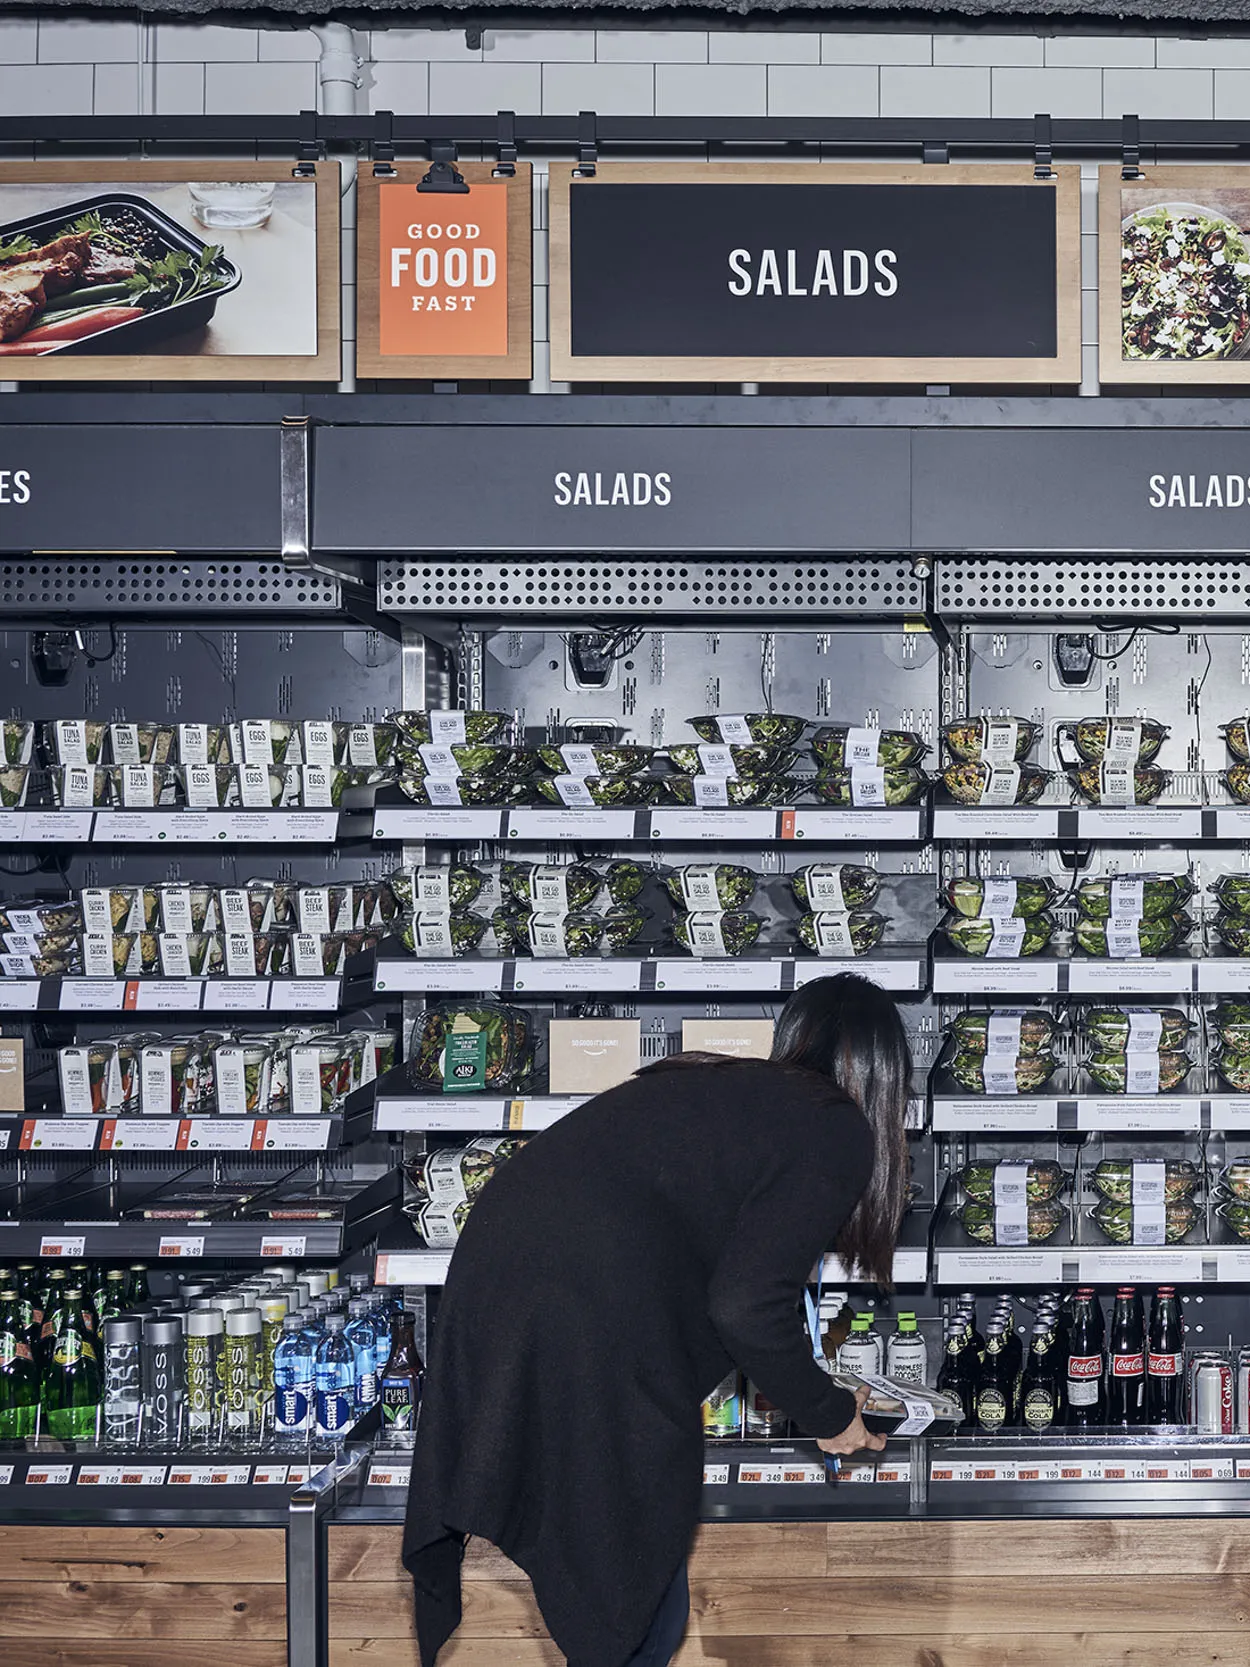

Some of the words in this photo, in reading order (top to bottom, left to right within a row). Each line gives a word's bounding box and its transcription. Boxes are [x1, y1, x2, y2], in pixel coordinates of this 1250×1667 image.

[408, 223, 479, 239] GOOD
[391, 247, 496, 288] FOOD
[728, 248, 898, 297] SALADS
[412, 295, 476, 311] FAST
[554, 471, 672, 506] SALADS
[249, 730, 266, 742] EGGS
[310, 731, 328, 742] EGGS
[353, 732, 369, 743] EGGS
[192, 772, 210, 783] EGGS
[245, 772, 263, 783] EGGS
[309, 774, 326, 785] EGGS
[227, 904, 244, 912] STEAK
[305, 904, 323, 912] STEAK
[232, 947, 249, 956] STEAK
[300, 947, 317, 956] STEAK
[156, 1352, 168, 1434] VOSS
[192, 1347, 205, 1430] VOSS
[232, 1347, 244, 1430] VOSS
[1222, 1376, 1232, 1408] Coke
[283, 1391, 295, 1424] smart
[325, 1394, 337, 1430] smart
